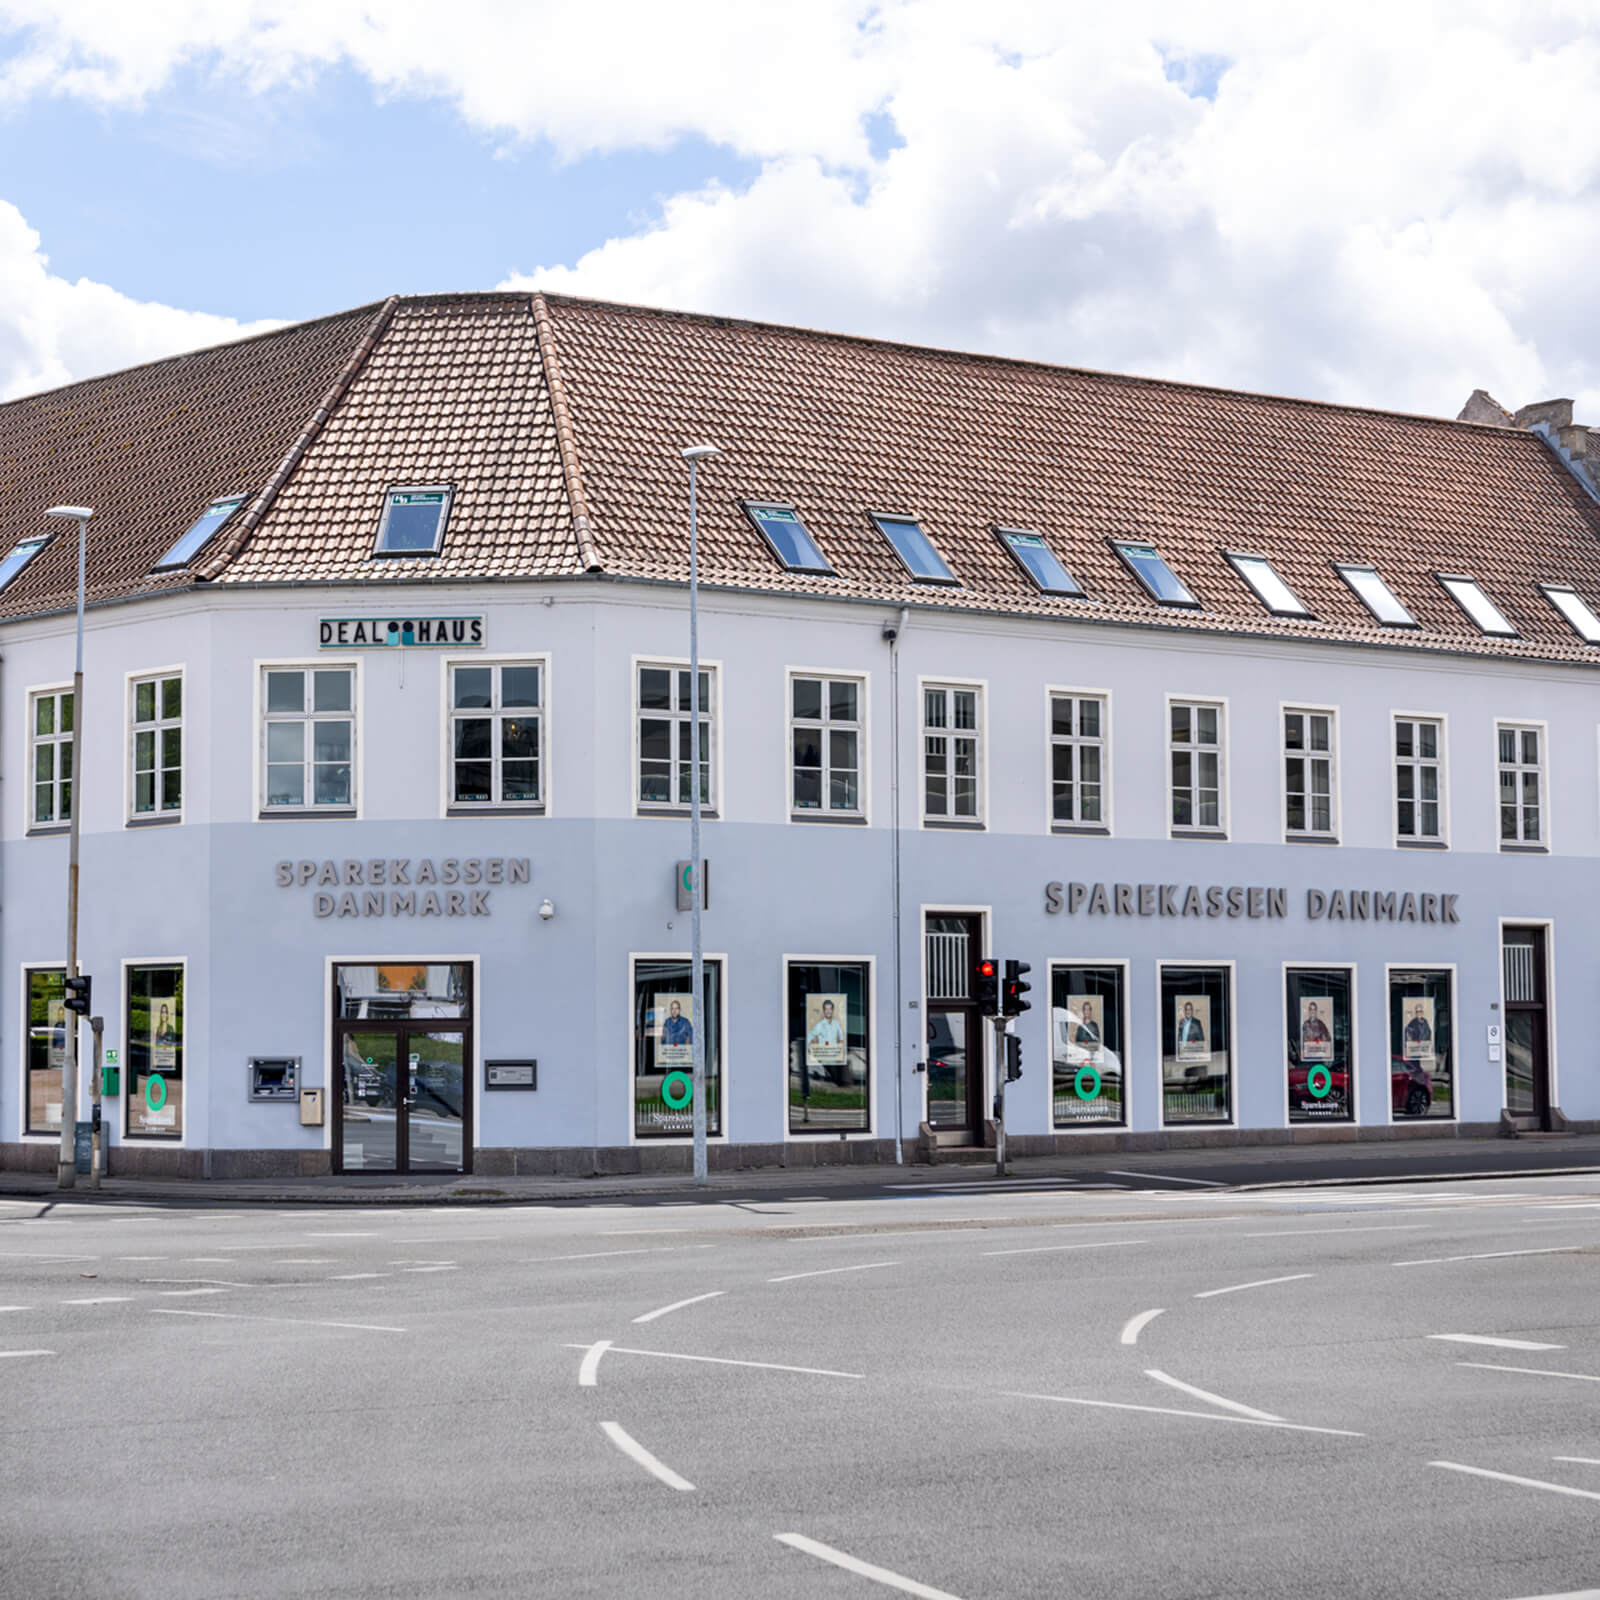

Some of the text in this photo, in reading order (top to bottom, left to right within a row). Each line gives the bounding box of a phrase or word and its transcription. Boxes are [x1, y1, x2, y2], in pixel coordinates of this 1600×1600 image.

[320, 620, 482, 643] DEAL HAUS
[275, 858, 530, 888] SPAREKASSEN
[314, 890, 491, 918] DANMARK
[1044, 881, 1461, 923] SPAREKASSEN DANMARK
